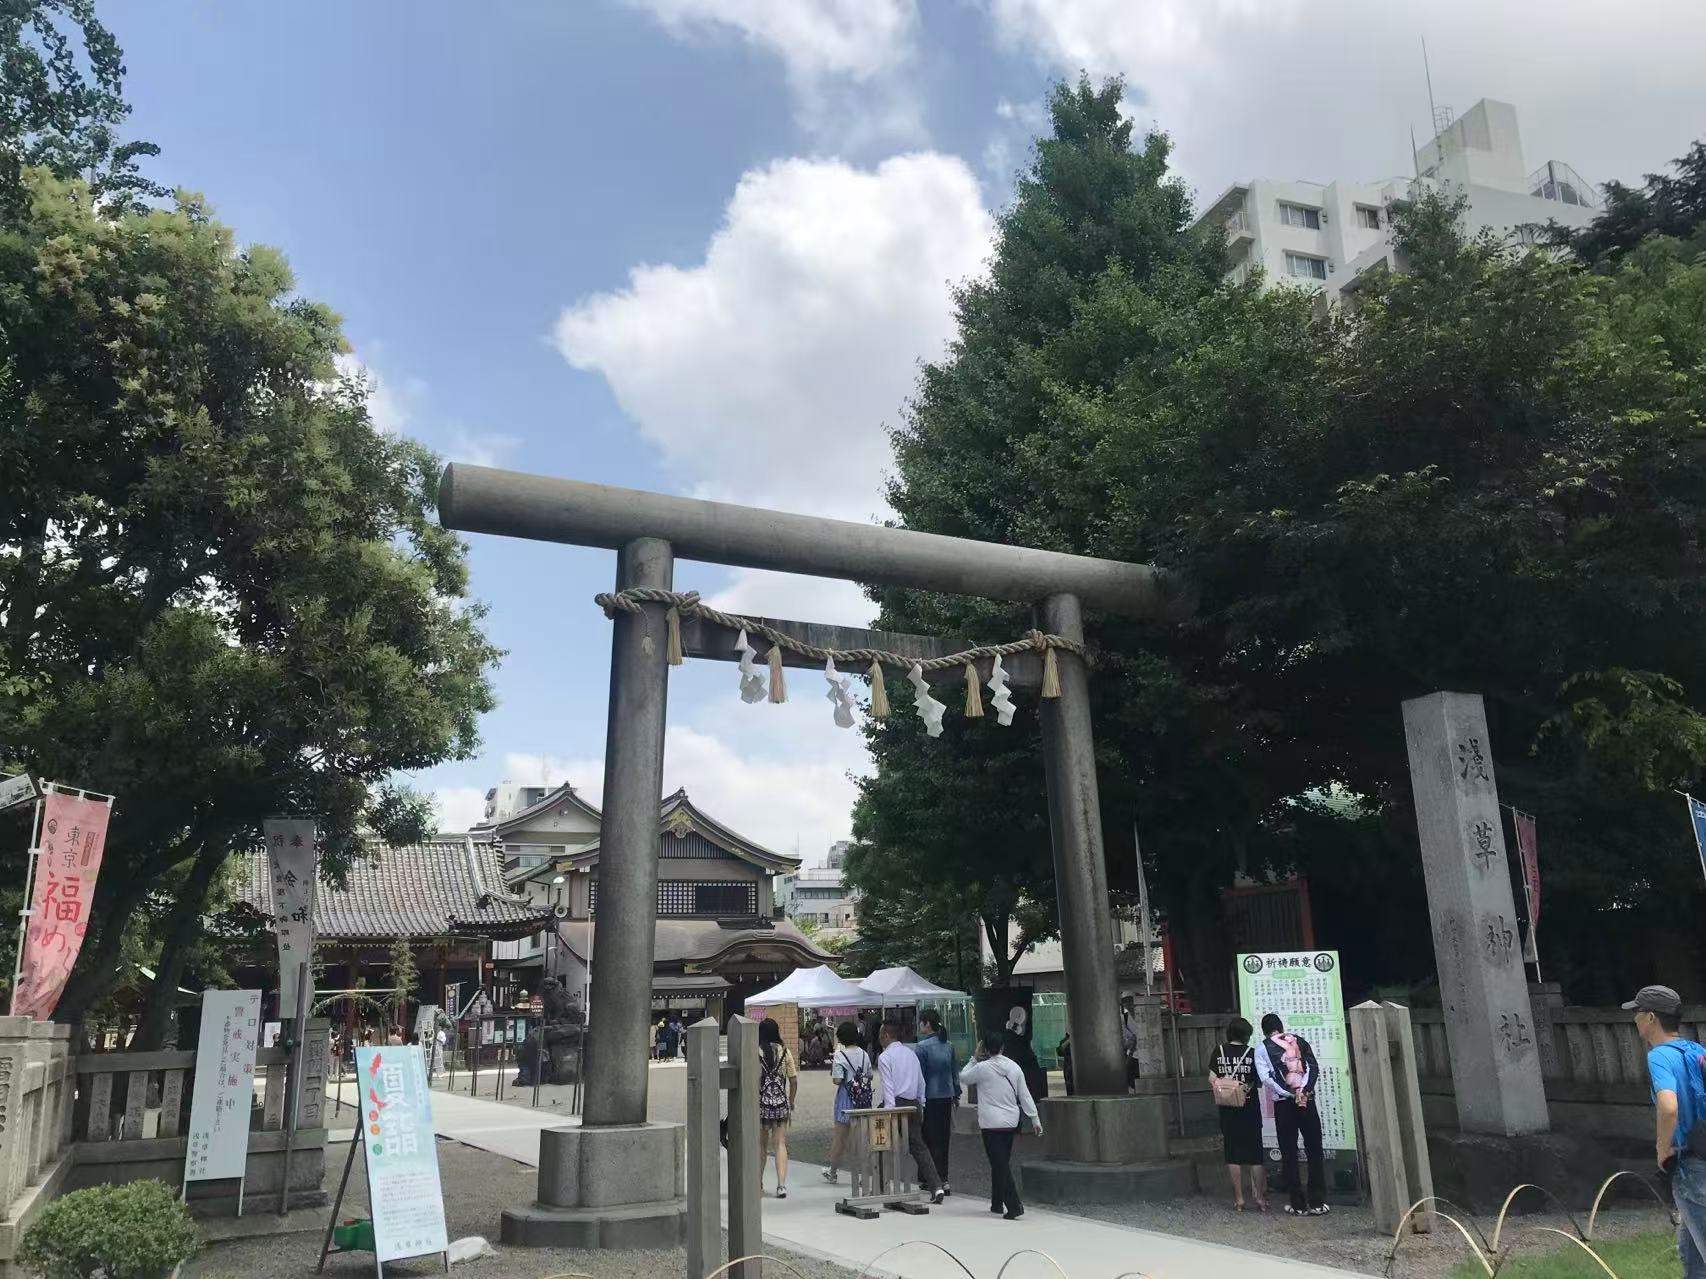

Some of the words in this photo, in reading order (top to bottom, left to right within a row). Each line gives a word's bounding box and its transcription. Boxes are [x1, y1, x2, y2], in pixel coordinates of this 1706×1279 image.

[61, 826, 81, 869] 東京
[225, 1006, 244, 1109] 警戒実施中
[243, 994, 259, 1074] テロ対策
[875, 1118, 886, 1146] 車止
